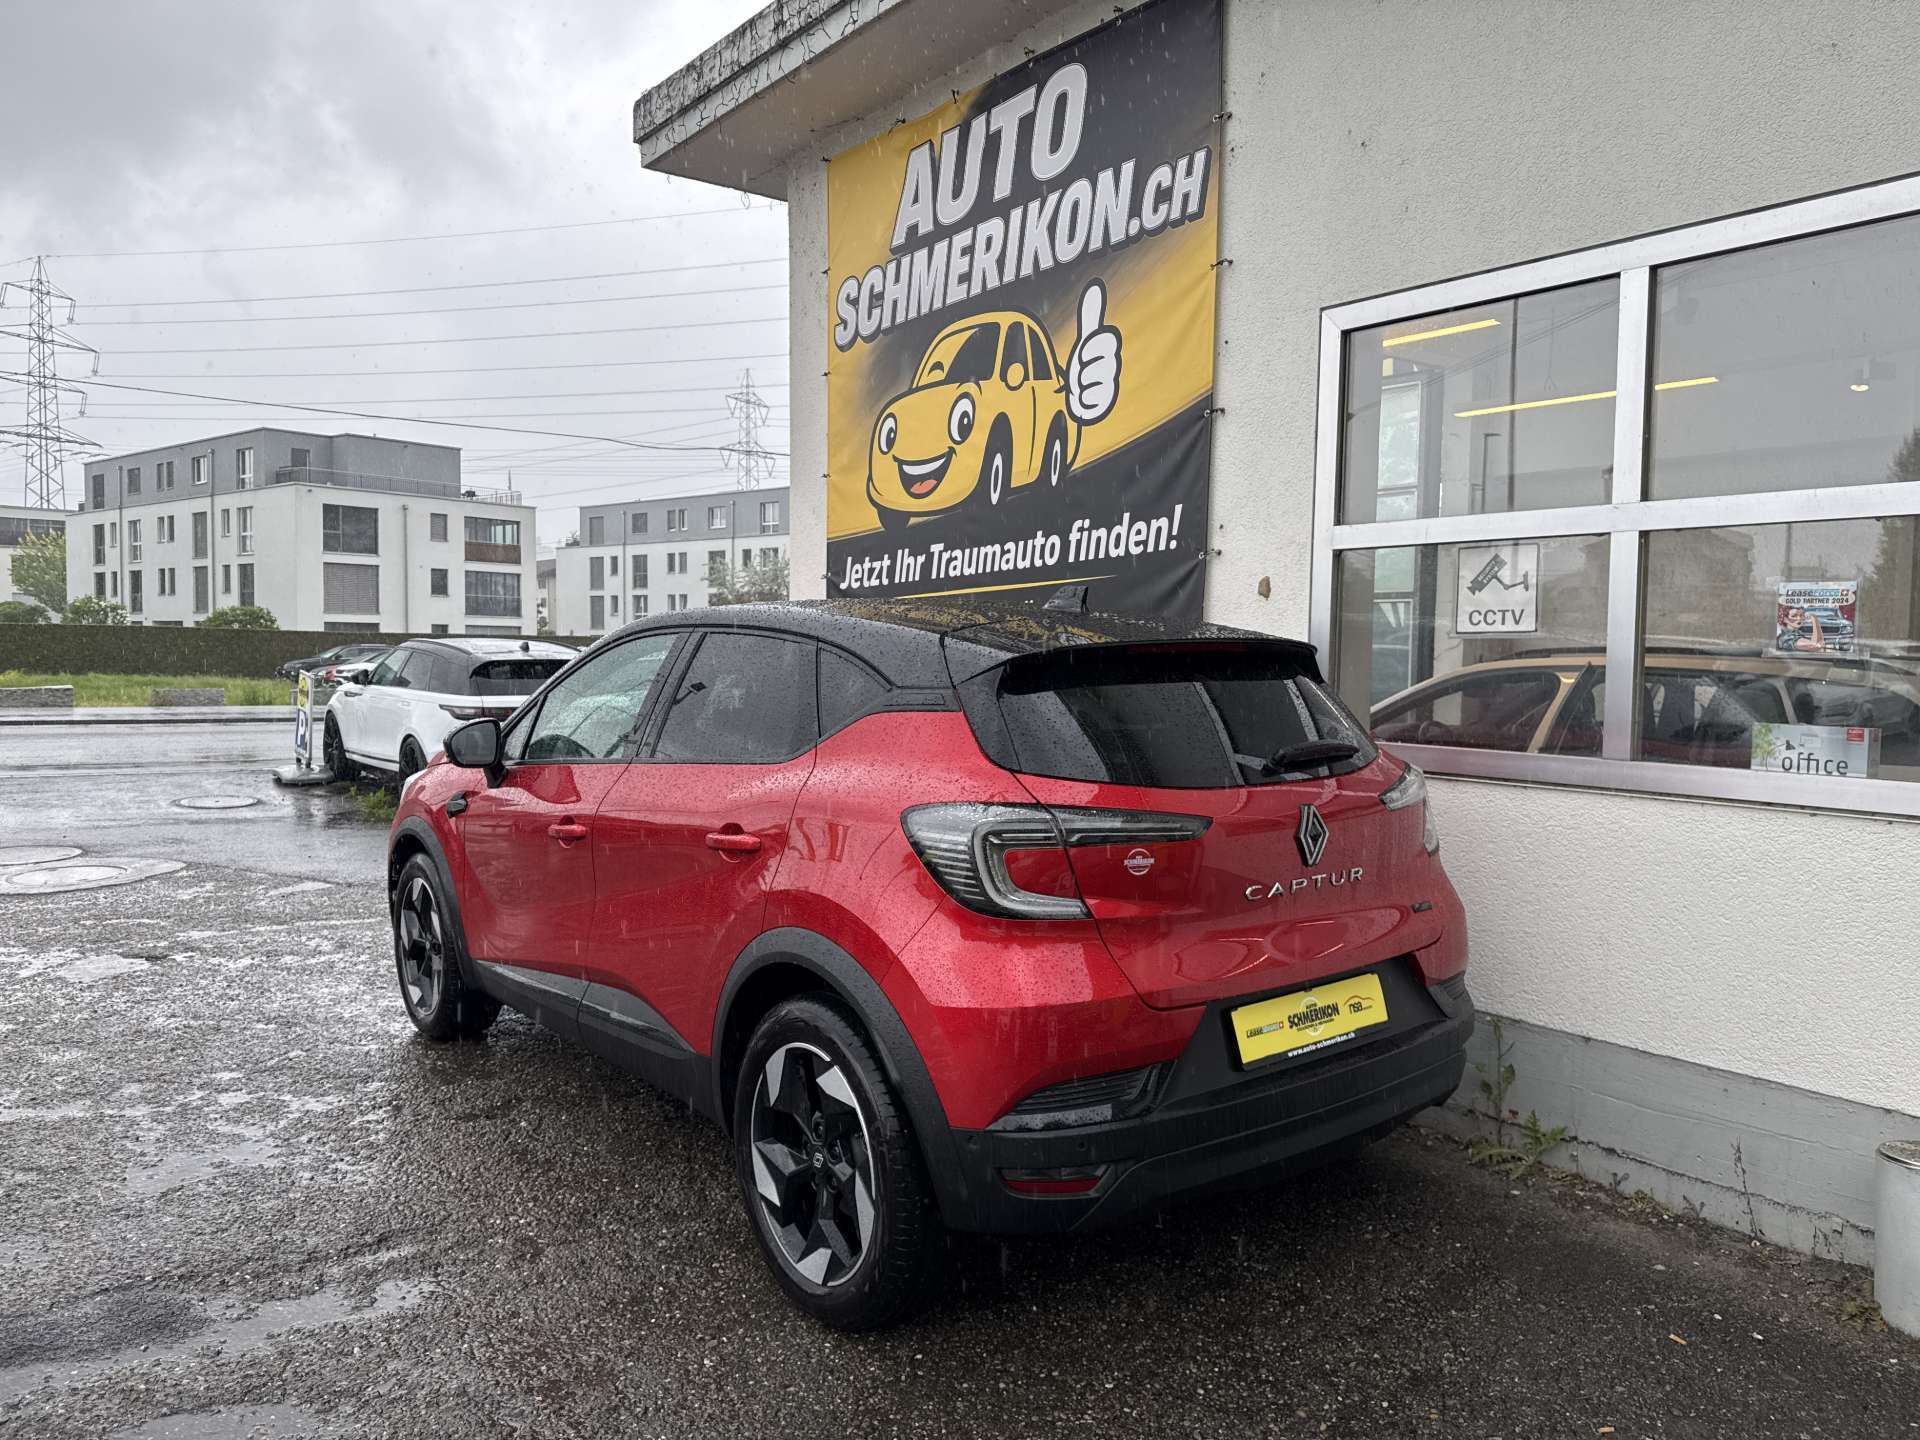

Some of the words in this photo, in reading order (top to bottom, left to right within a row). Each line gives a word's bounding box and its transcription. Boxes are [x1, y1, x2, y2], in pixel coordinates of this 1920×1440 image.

[891, 62, 1088, 249] AUTO
[834, 147, 1209, 348] SCHMERIKON.CH
[839, 556, 891, 590] Jetzt
[894, 549, 926, 584] Ihr
[930, 530, 1061, 580] Traumauto
[1068, 503, 1184, 563] finden!
[1832, 597, 1849, 605] 2024
[1468, 608, 1525, 626] CCTV
[1781, 752, 1849, 776] office
[1245, 867, 1364, 900] CAPTUR
[1288, 1003, 1340, 1029] SCHMERIKON
[1288, 1031, 1356, 1057] www.auto-schmerikon.ch
